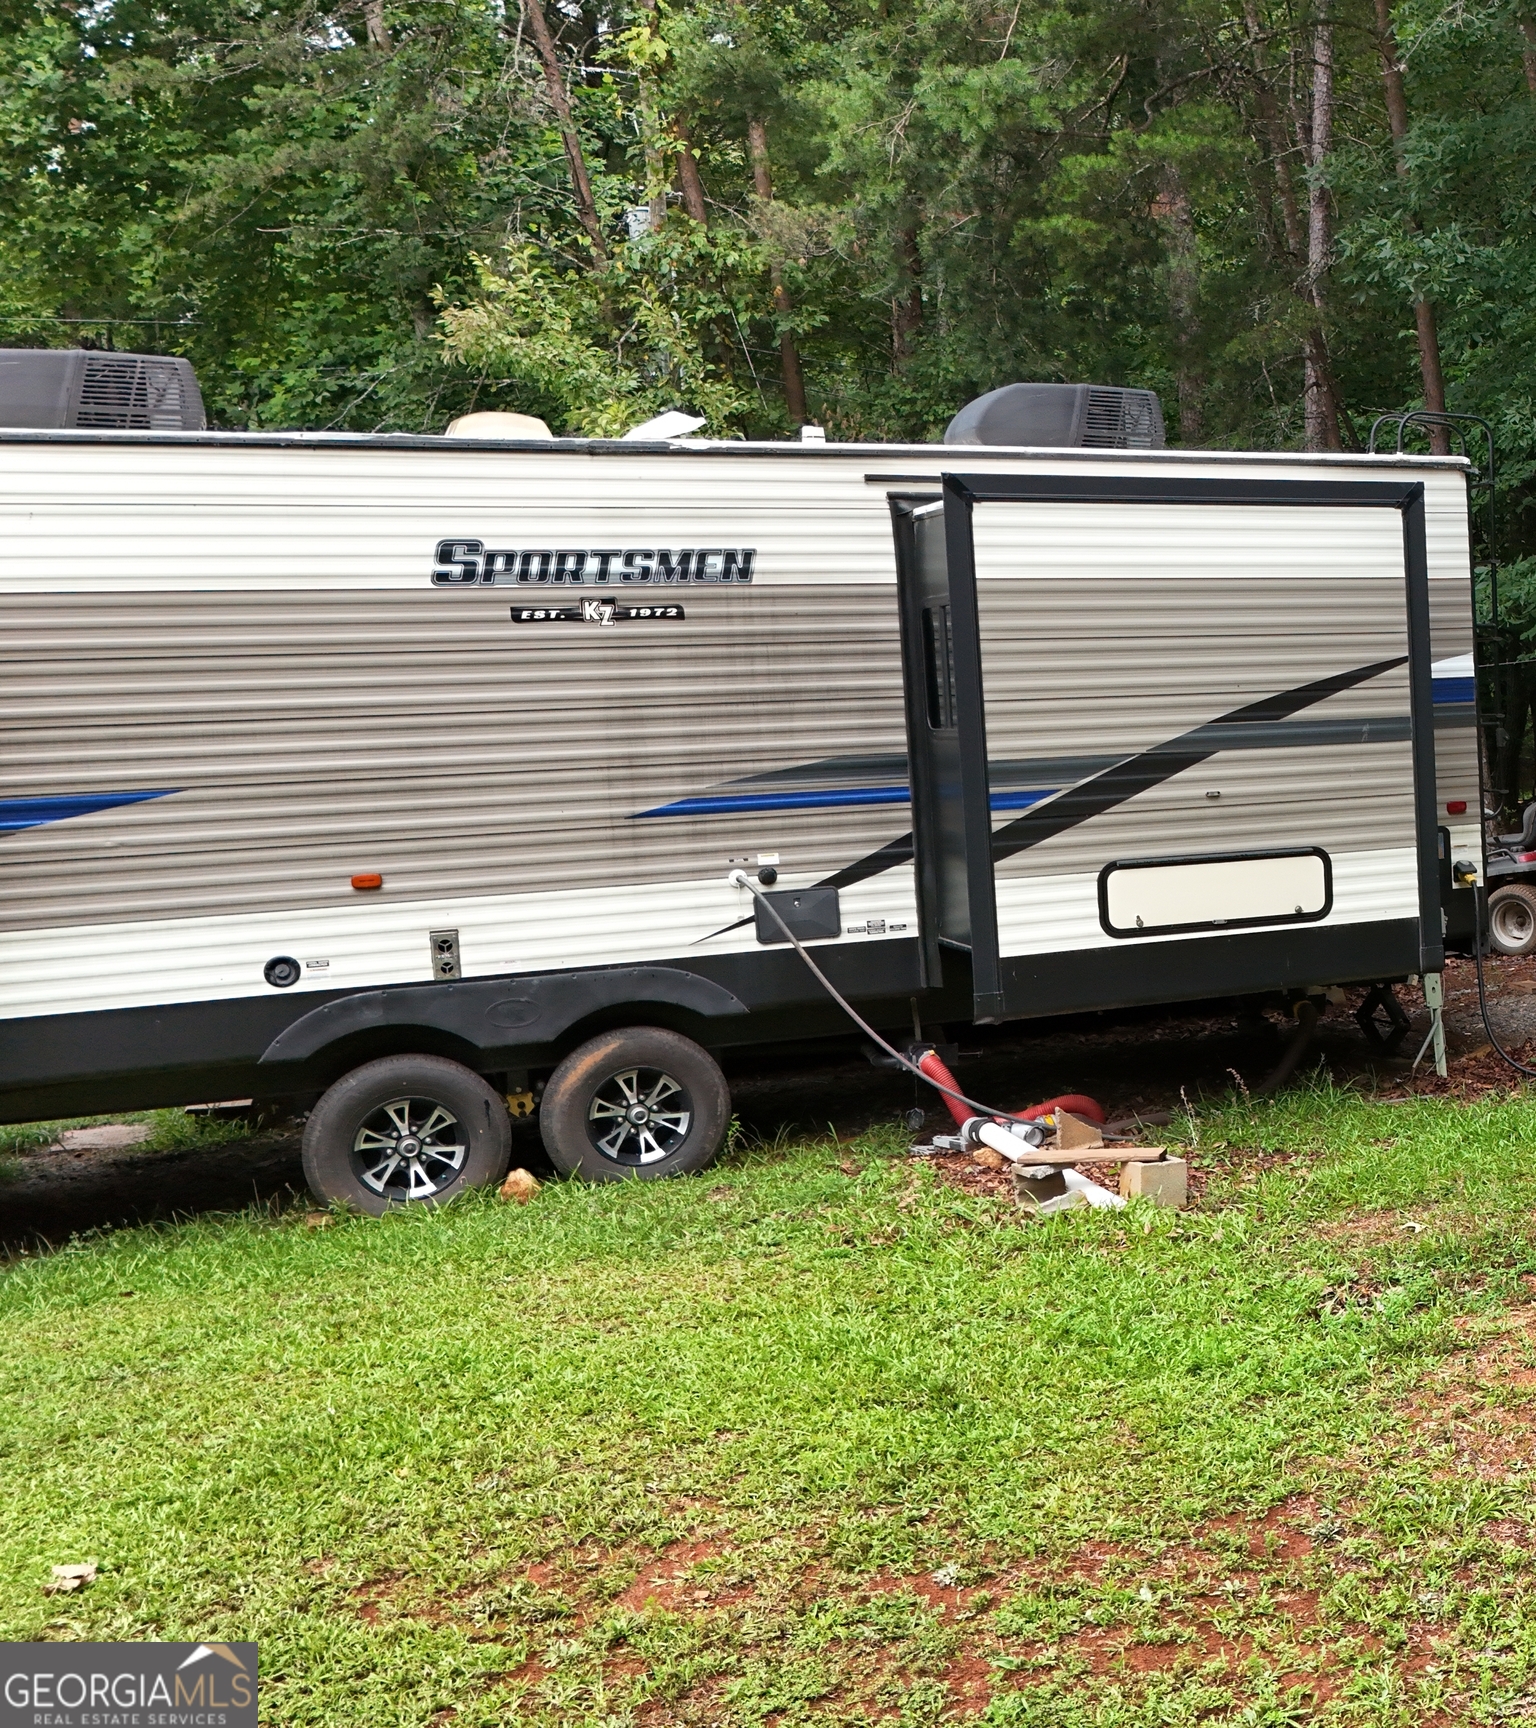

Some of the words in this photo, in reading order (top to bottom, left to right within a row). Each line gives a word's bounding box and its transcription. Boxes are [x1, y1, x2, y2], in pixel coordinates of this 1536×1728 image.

[431, 539, 757, 586] SPORTSMEN
[520, 610, 566, 620] EST.
[583, 600, 615, 627] KZ
[629, 607, 679, 617] 1972
